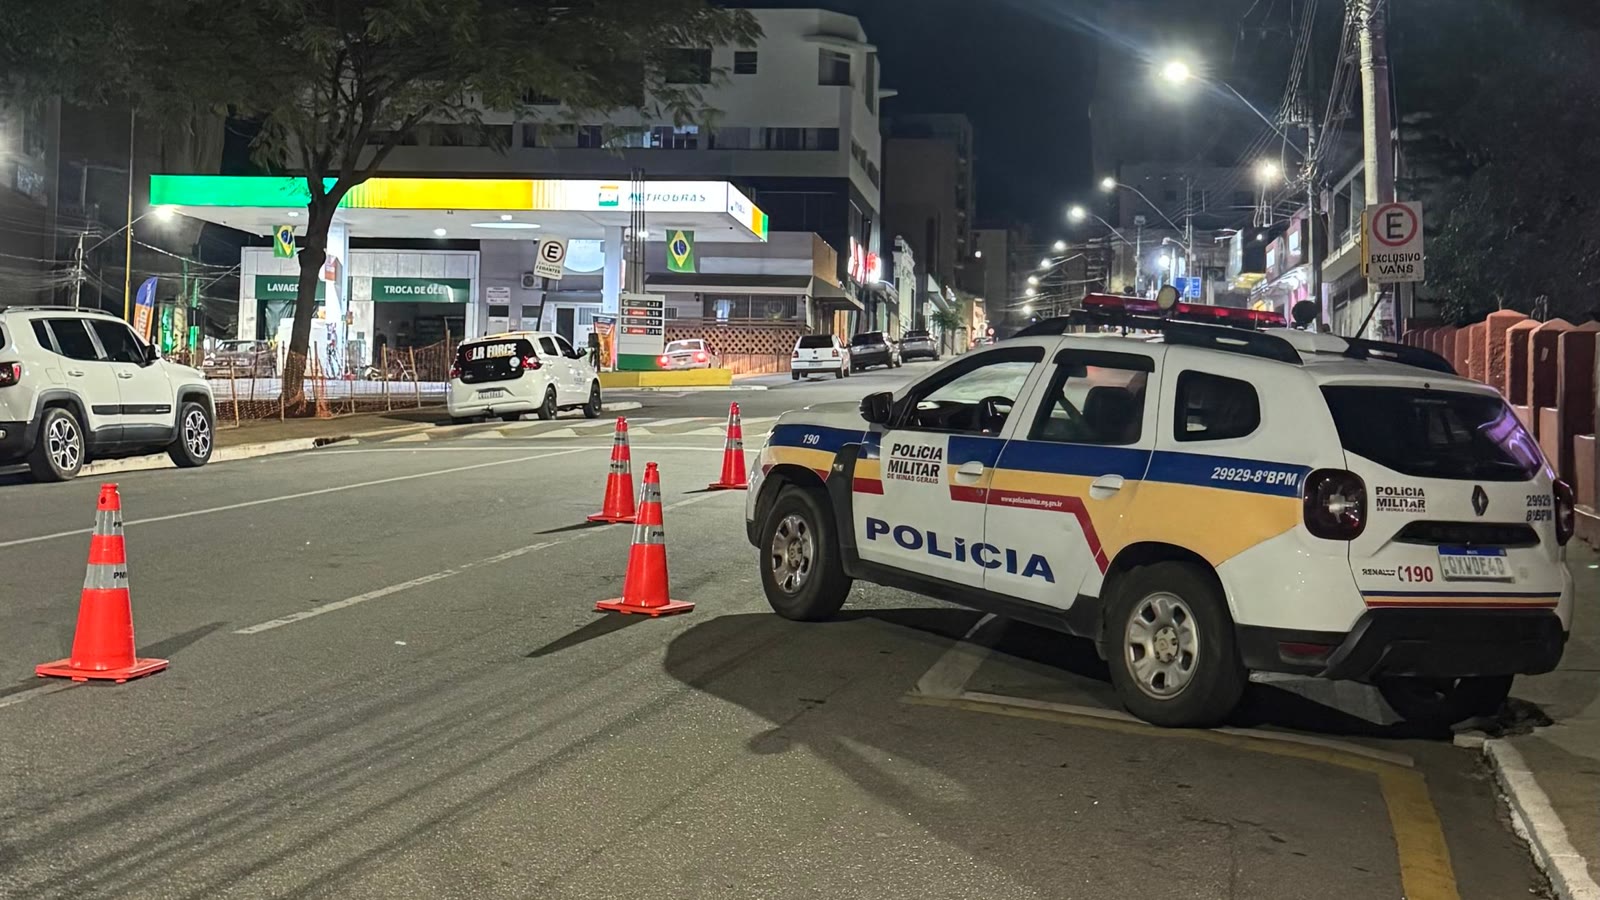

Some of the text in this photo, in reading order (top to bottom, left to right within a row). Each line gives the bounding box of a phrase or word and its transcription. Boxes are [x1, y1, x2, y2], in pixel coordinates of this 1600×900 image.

[1386, 213, 1404, 239] E
[546, 245, 559, 260] E
[1371, 253, 1420, 263] EXCLUSIVO
[1379, 264, 1414, 275] VANS
[384, 285, 413, 294] TROCA
[414, 285, 426, 295] DE
[486, 343, 517, 358] FORCE
[802, 434, 820, 445] 190
[888, 460, 941, 477] MILITAR
[916, 476, 939, 484] GERAIS
[1376, 498, 1426, 508] MILITAR
[1362, 566, 1434, 582] RENA 190
